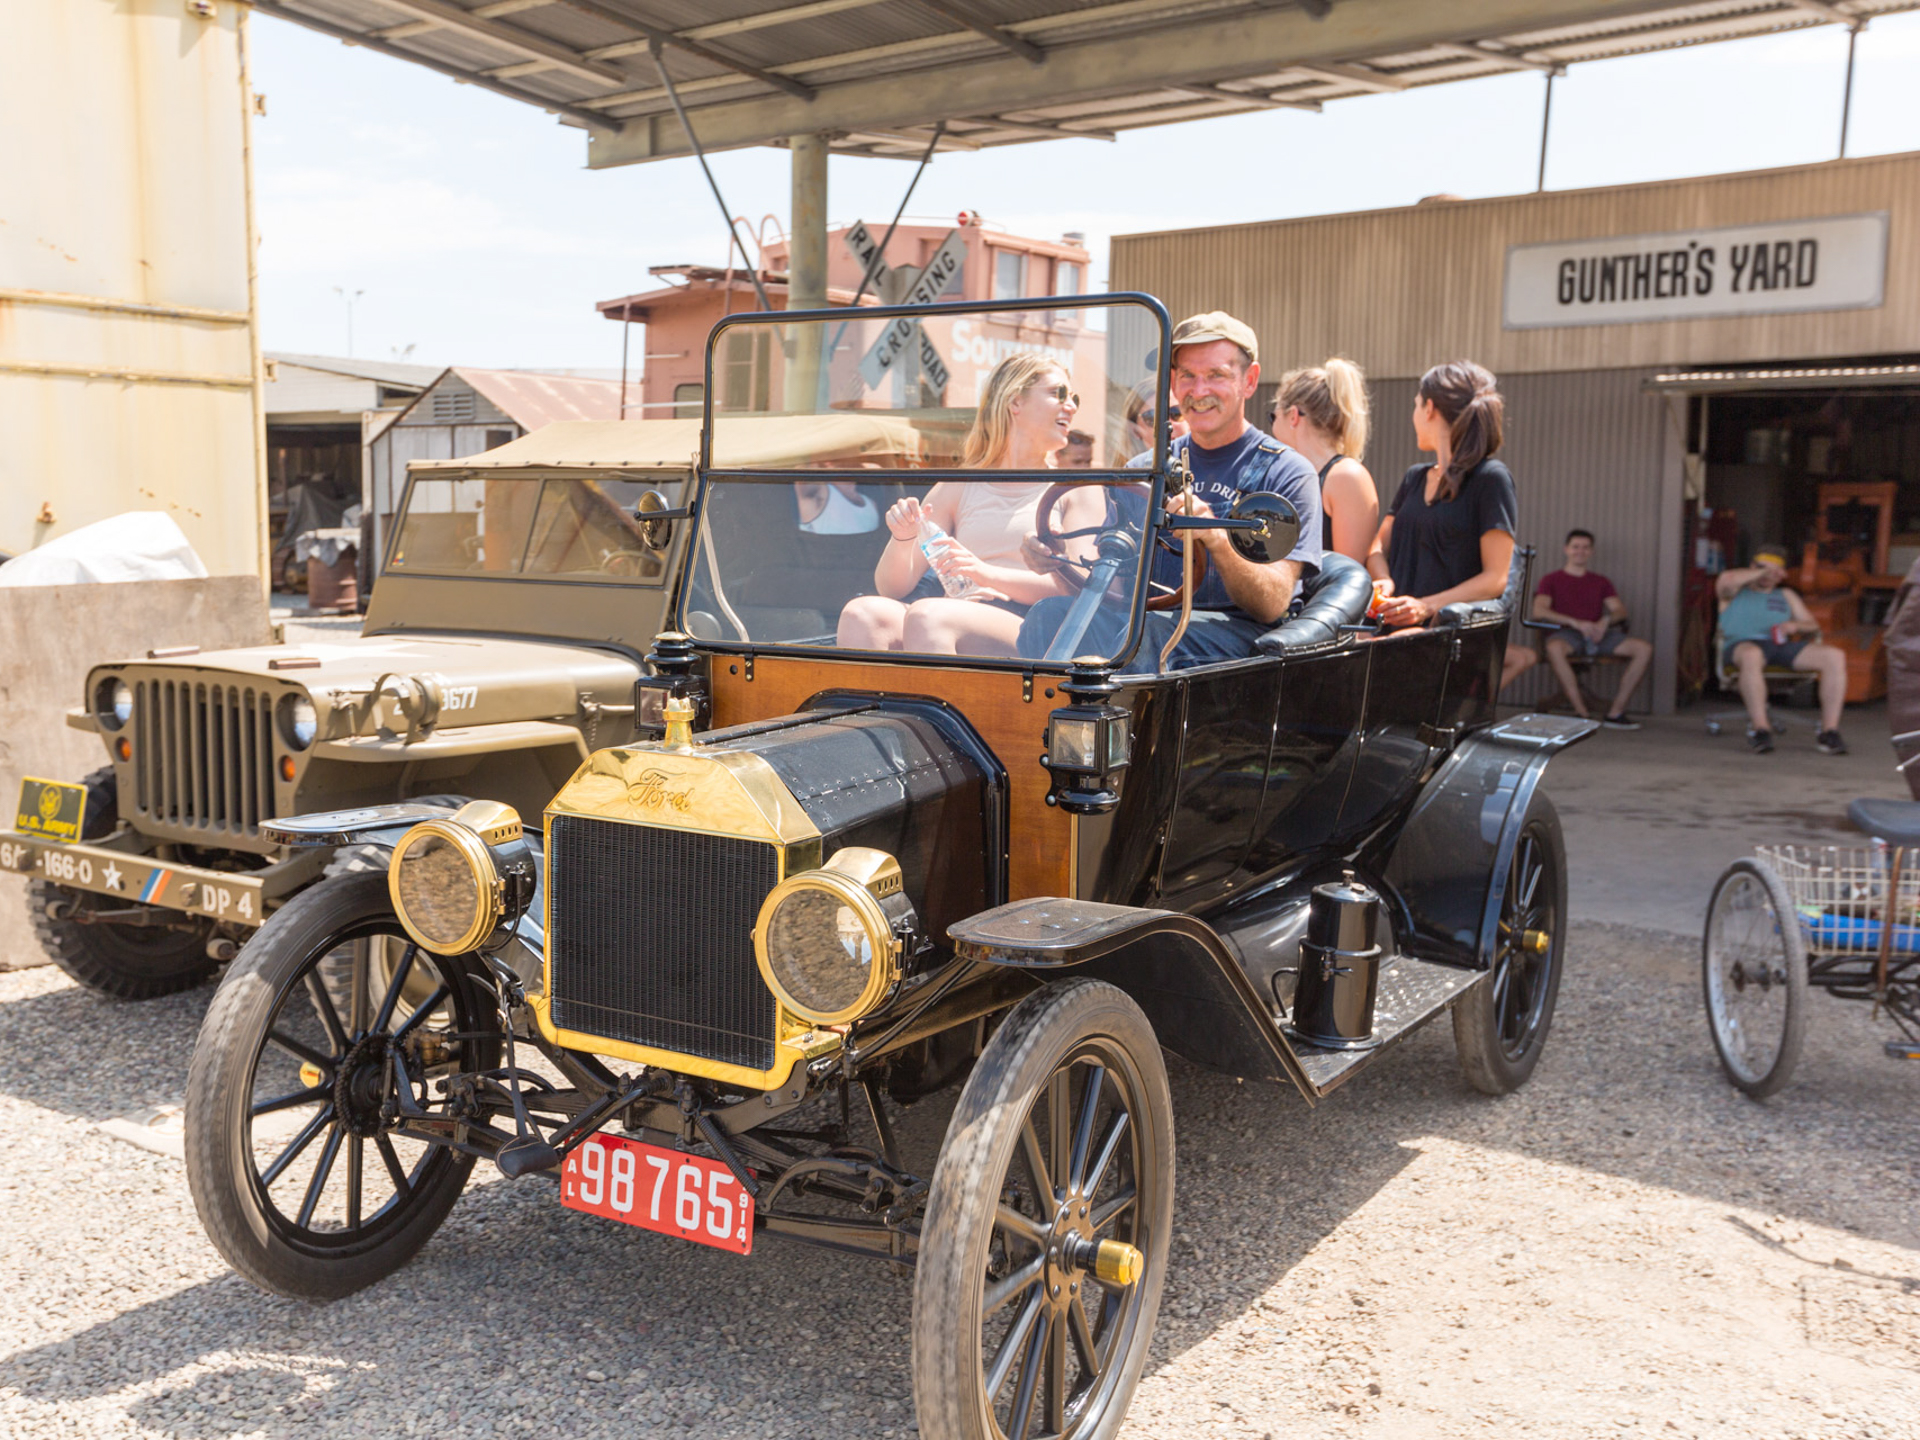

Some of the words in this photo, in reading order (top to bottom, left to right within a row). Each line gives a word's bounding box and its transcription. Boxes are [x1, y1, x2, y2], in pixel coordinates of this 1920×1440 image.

[851, 227, 886, 287] RAL
[1557, 241, 1715, 305] GUNTHER'S
[1730, 239, 1819, 293] YARD
[876, 251, 956, 367] CROSING
[1210, 482, 1239, 500] DRI
[628, 768, 695, 811] Ford
[17, 813, 40, 829] U.S.
[42, 819, 77, 836] ARMY
[202, 884, 231, 915] DP
[237, 891, 253, 919] 4
